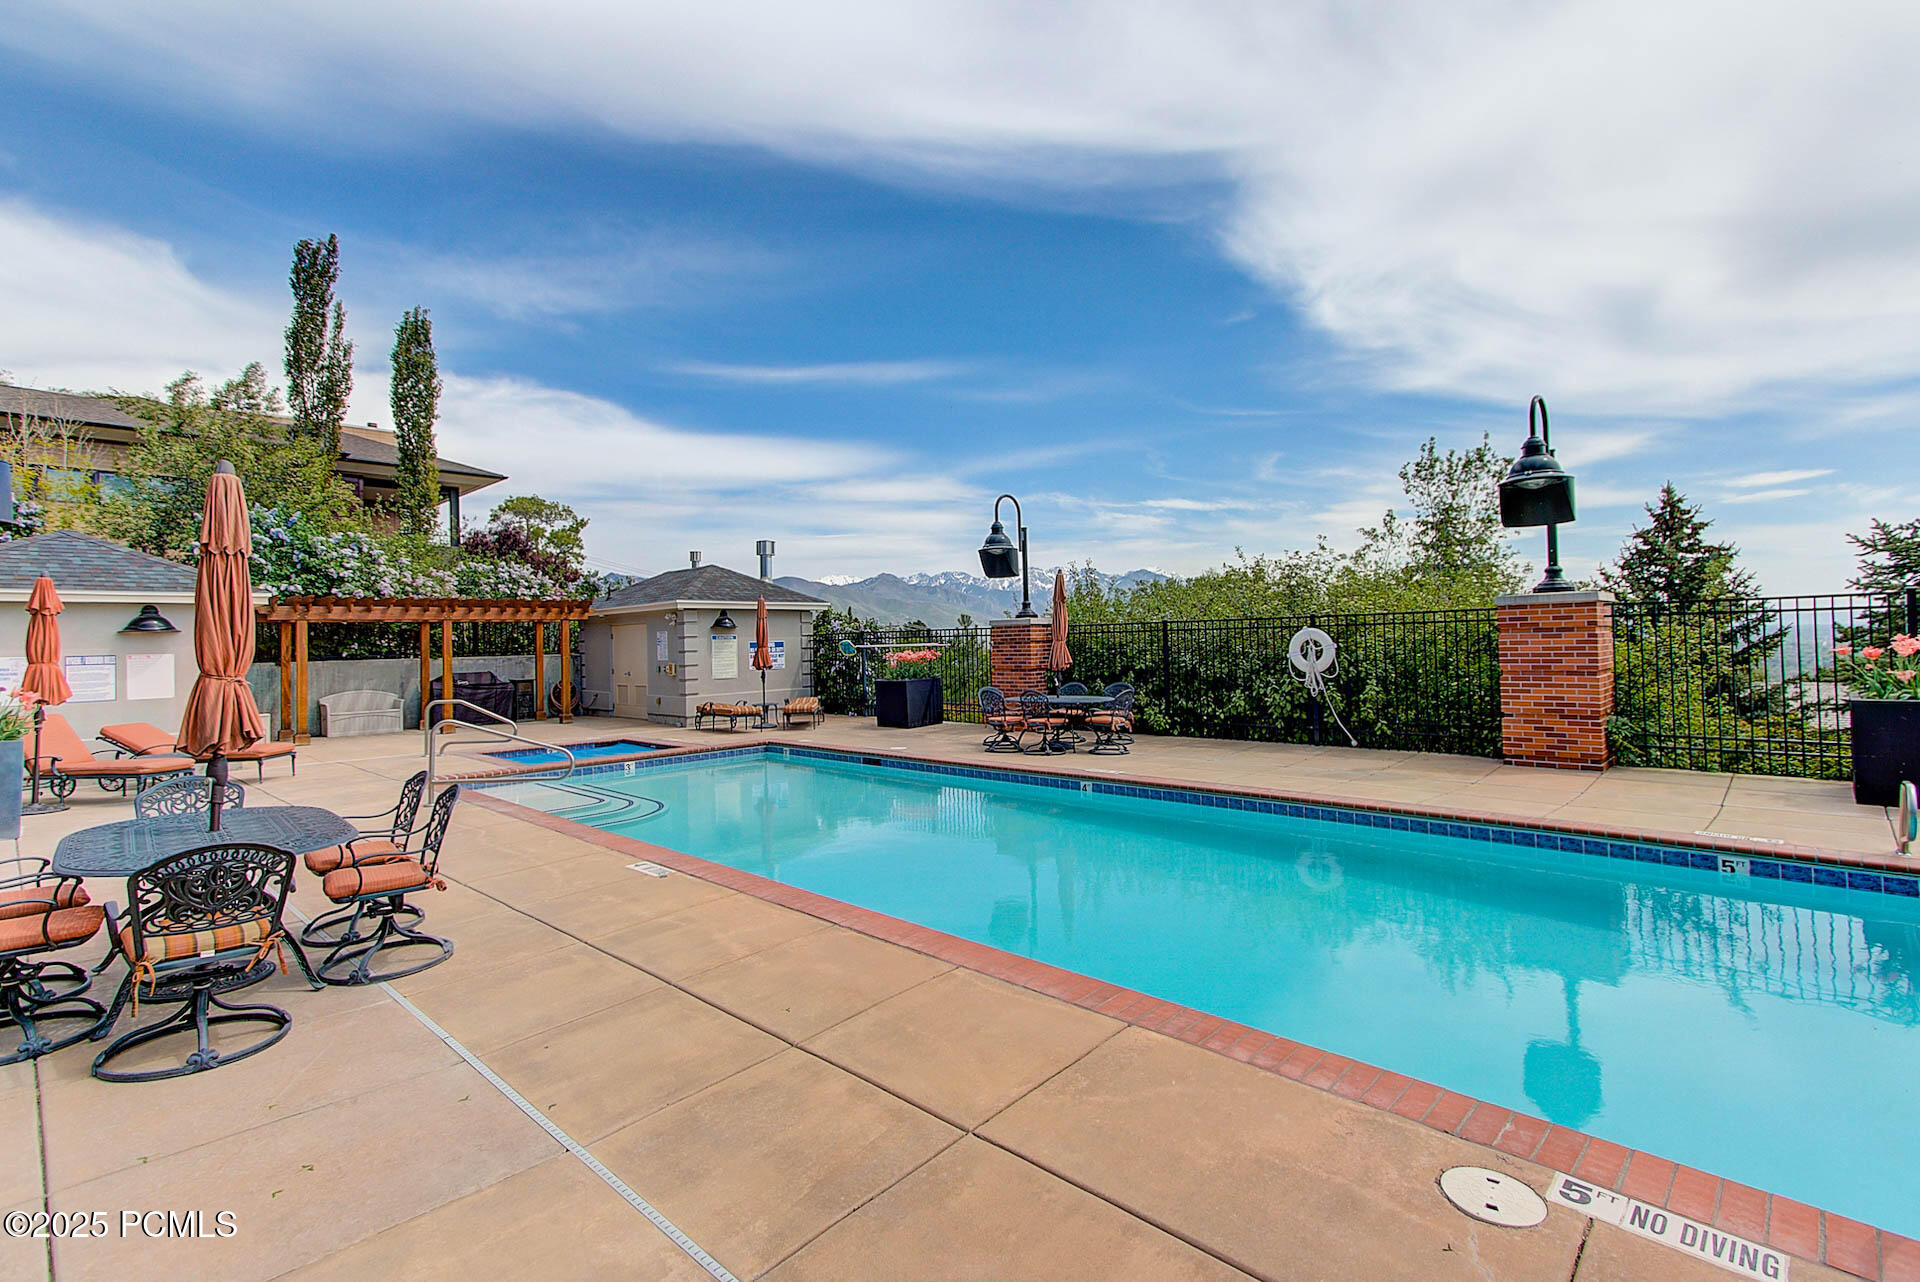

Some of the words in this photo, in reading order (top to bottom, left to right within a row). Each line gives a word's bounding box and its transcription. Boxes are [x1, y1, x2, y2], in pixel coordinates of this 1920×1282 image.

[1081, 783, 1088, 792] 4
[1721, 859, 1736, 874] 5
[1559, 1178, 1594, 1206] 5
[1596, 1190, 1621, 1204] FT
[1629, 1204, 1669, 1236] NO
[1680, 1222, 1780, 1280] DIVING
